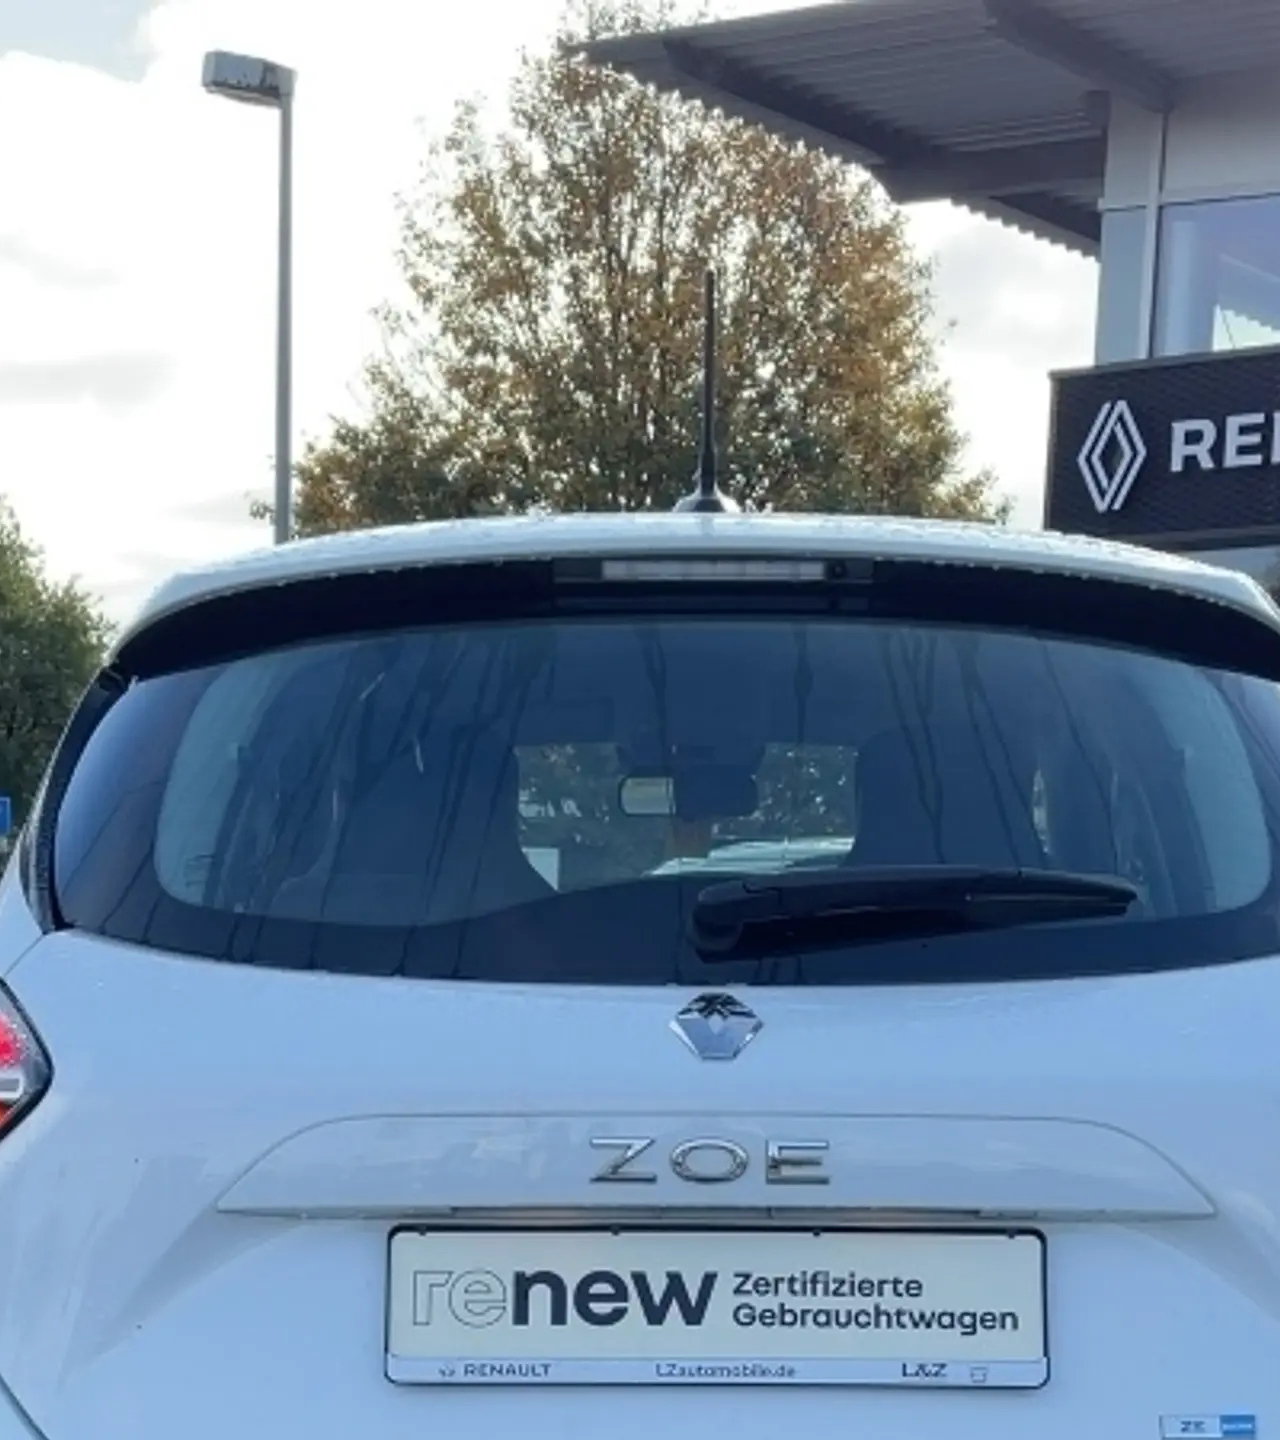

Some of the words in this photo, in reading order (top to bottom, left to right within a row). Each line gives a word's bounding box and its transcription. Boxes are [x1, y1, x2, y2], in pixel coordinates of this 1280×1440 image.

[588, 1136, 831, 1185] ZOE
[412, 1267, 719, 1329] renew
[732, 1270, 923, 1298] Zertifizierte
[732, 1302, 1019, 1336] Gebrauchtwagen
[463, 1362, 552, 1378] RENAULT
[656, 1362, 797, 1379] LZautomobile.de
